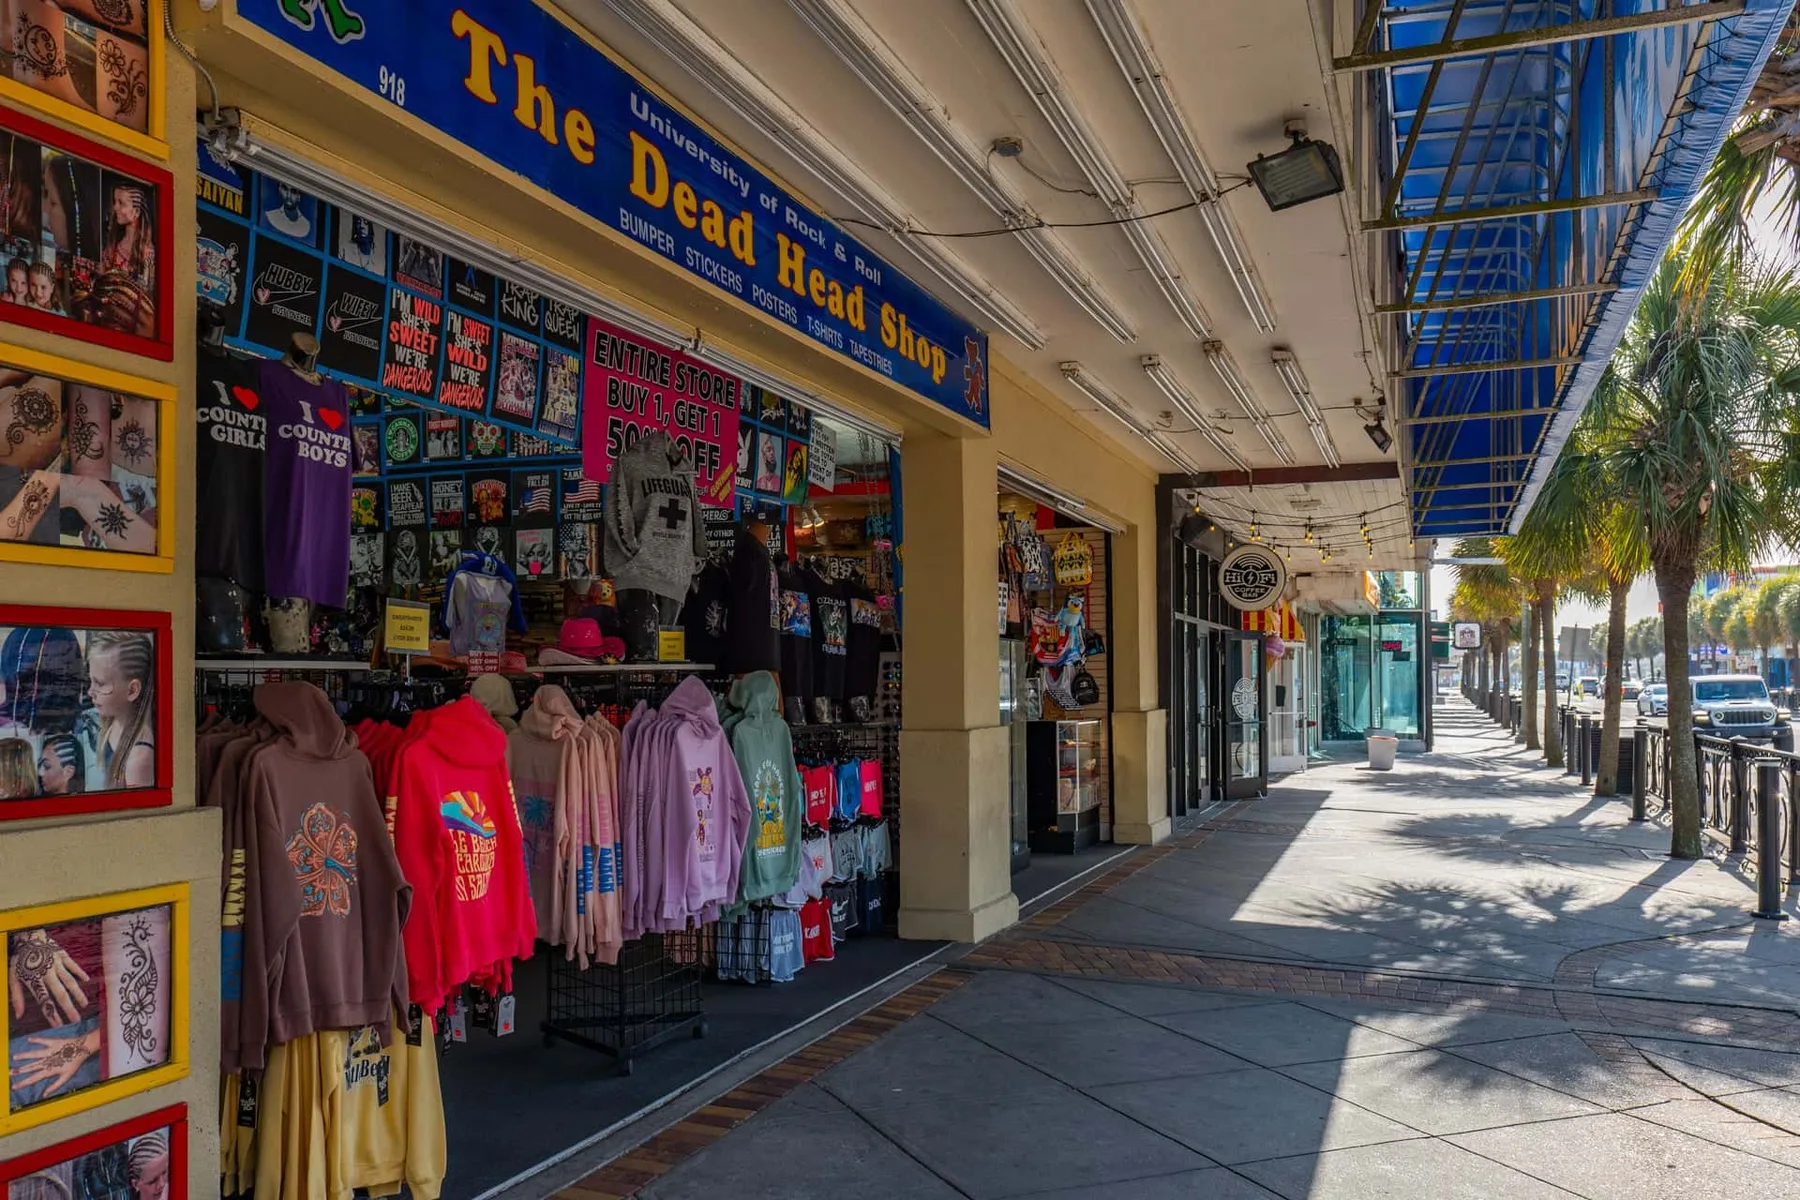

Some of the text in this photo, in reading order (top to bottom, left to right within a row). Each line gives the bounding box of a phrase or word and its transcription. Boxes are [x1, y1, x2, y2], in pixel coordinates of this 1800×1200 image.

[379, 65, 405, 107] 918
[450, 8, 597, 164] The
[196, 174, 244, 215] SAIYAN
[630, 92, 881, 285] University of Rock & Roll
[629, 129, 946, 384] Dead Head Shop
[264, 262, 313, 294] HUBBY
[619, 207, 893, 376] BUMPER STICKERS POSTERS T-SHIRTS TAPESTRIES
[340, 291, 379, 320] WIFEY
[391, 287, 440, 325] I'M WILD
[501, 293, 539, 327] KING
[389, 320, 438, 356] SWEET
[400, 311, 431, 334] SHE'S
[447, 310, 463, 335] I'M
[463, 318, 491, 346] SWEET
[544, 310, 580, 344] QUEEN
[395, 344, 428, 370] WE'RE
[447, 343, 488, 373] WILD
[453, 334, 483, 356] SHE'S
[382, 362, 432, 394] DANGEROUS
[450, 363, 481, 388] WE'RE
[593, 329, 671, 388] ENTIRE
[674, 360, 736, 410] STORE
[212, 380, 231, 406] I
[439, 380, 485, 410] DANGEROUS
[606, 376, 650, 416] BUY
[653, 392, 670, 427] 1,
[673, 398, 709, 434] GET
[712, 410, 721, 437] 1
[196, 405, 268, 436] COUNT
[299, 400, 315, 425] I
[278, 423, 352, 453] COUNTR
[606, 415, 658, 460] 50
[674, 433, 721, 481] OFF
[298, 441, 348, 468] BOYS
[391, 492, 412, 504] BEER
[394, 482, 412, 493] MAKE
[432, 482, 462, 494] MONEY
[641, 477, 692, 498] LIFEGUA
[1224, 572, 1276, 584] Hi Fi
